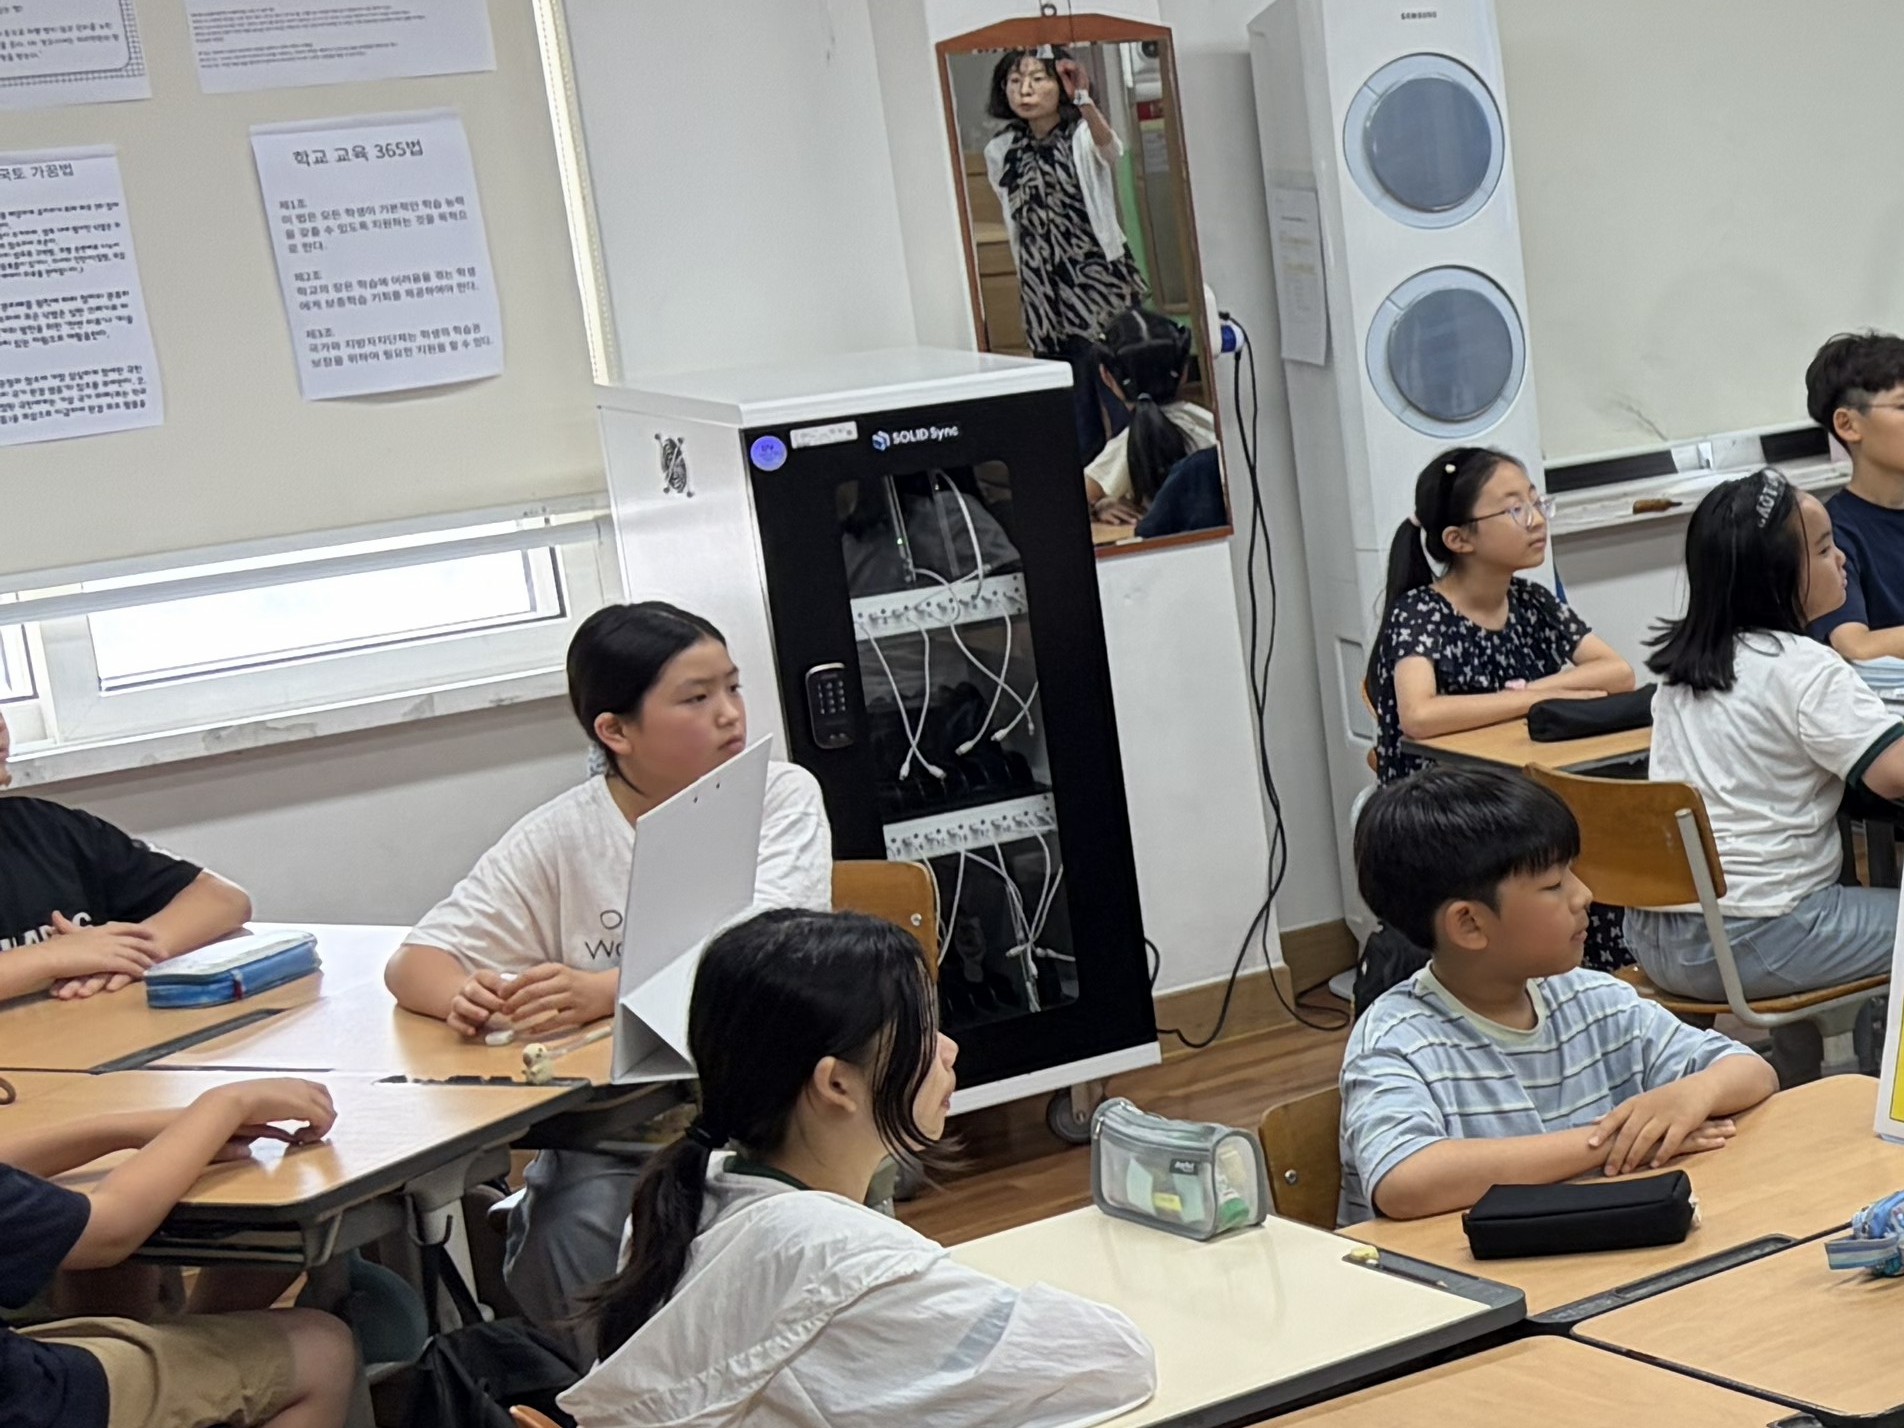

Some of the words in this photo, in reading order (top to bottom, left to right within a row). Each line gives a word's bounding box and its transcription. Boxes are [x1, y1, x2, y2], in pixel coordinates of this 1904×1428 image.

[292, 149, 329, 167] 학교
[334, 145, 370, 163] 교육
[374, 139, 424, 160] 365법
[892, 428, 929, 445] SOLID
[930, 425, 959, 442] Sync
